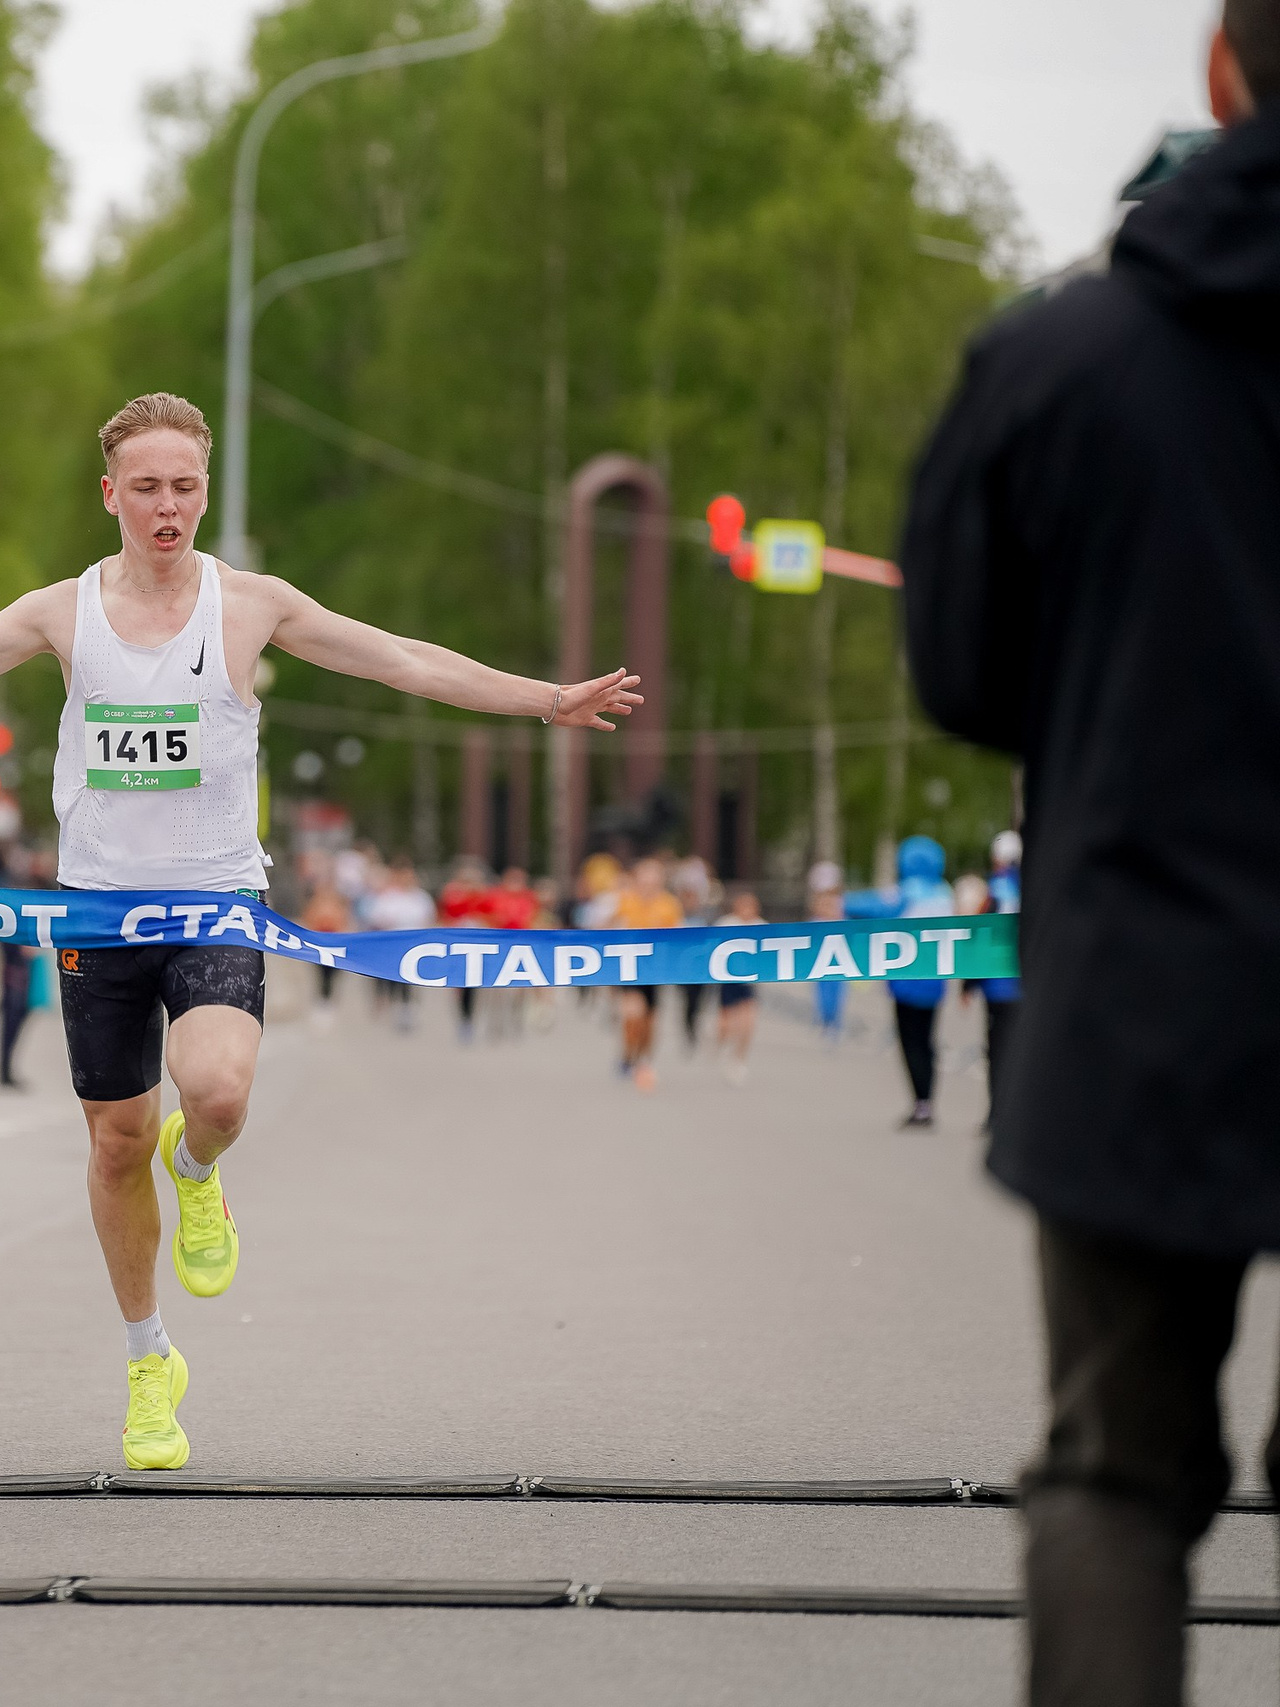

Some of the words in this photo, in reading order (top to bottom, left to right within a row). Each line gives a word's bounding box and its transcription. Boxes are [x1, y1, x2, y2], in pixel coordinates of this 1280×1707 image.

[97, 729, 188, 763] 1415
[120, 772, 143, 788] 4,2
[120, 904, 347, 967] СТАРТ
[398, 942, 654, 987] СТАРТ
[708, 928, 971, 981] СТАРТ
